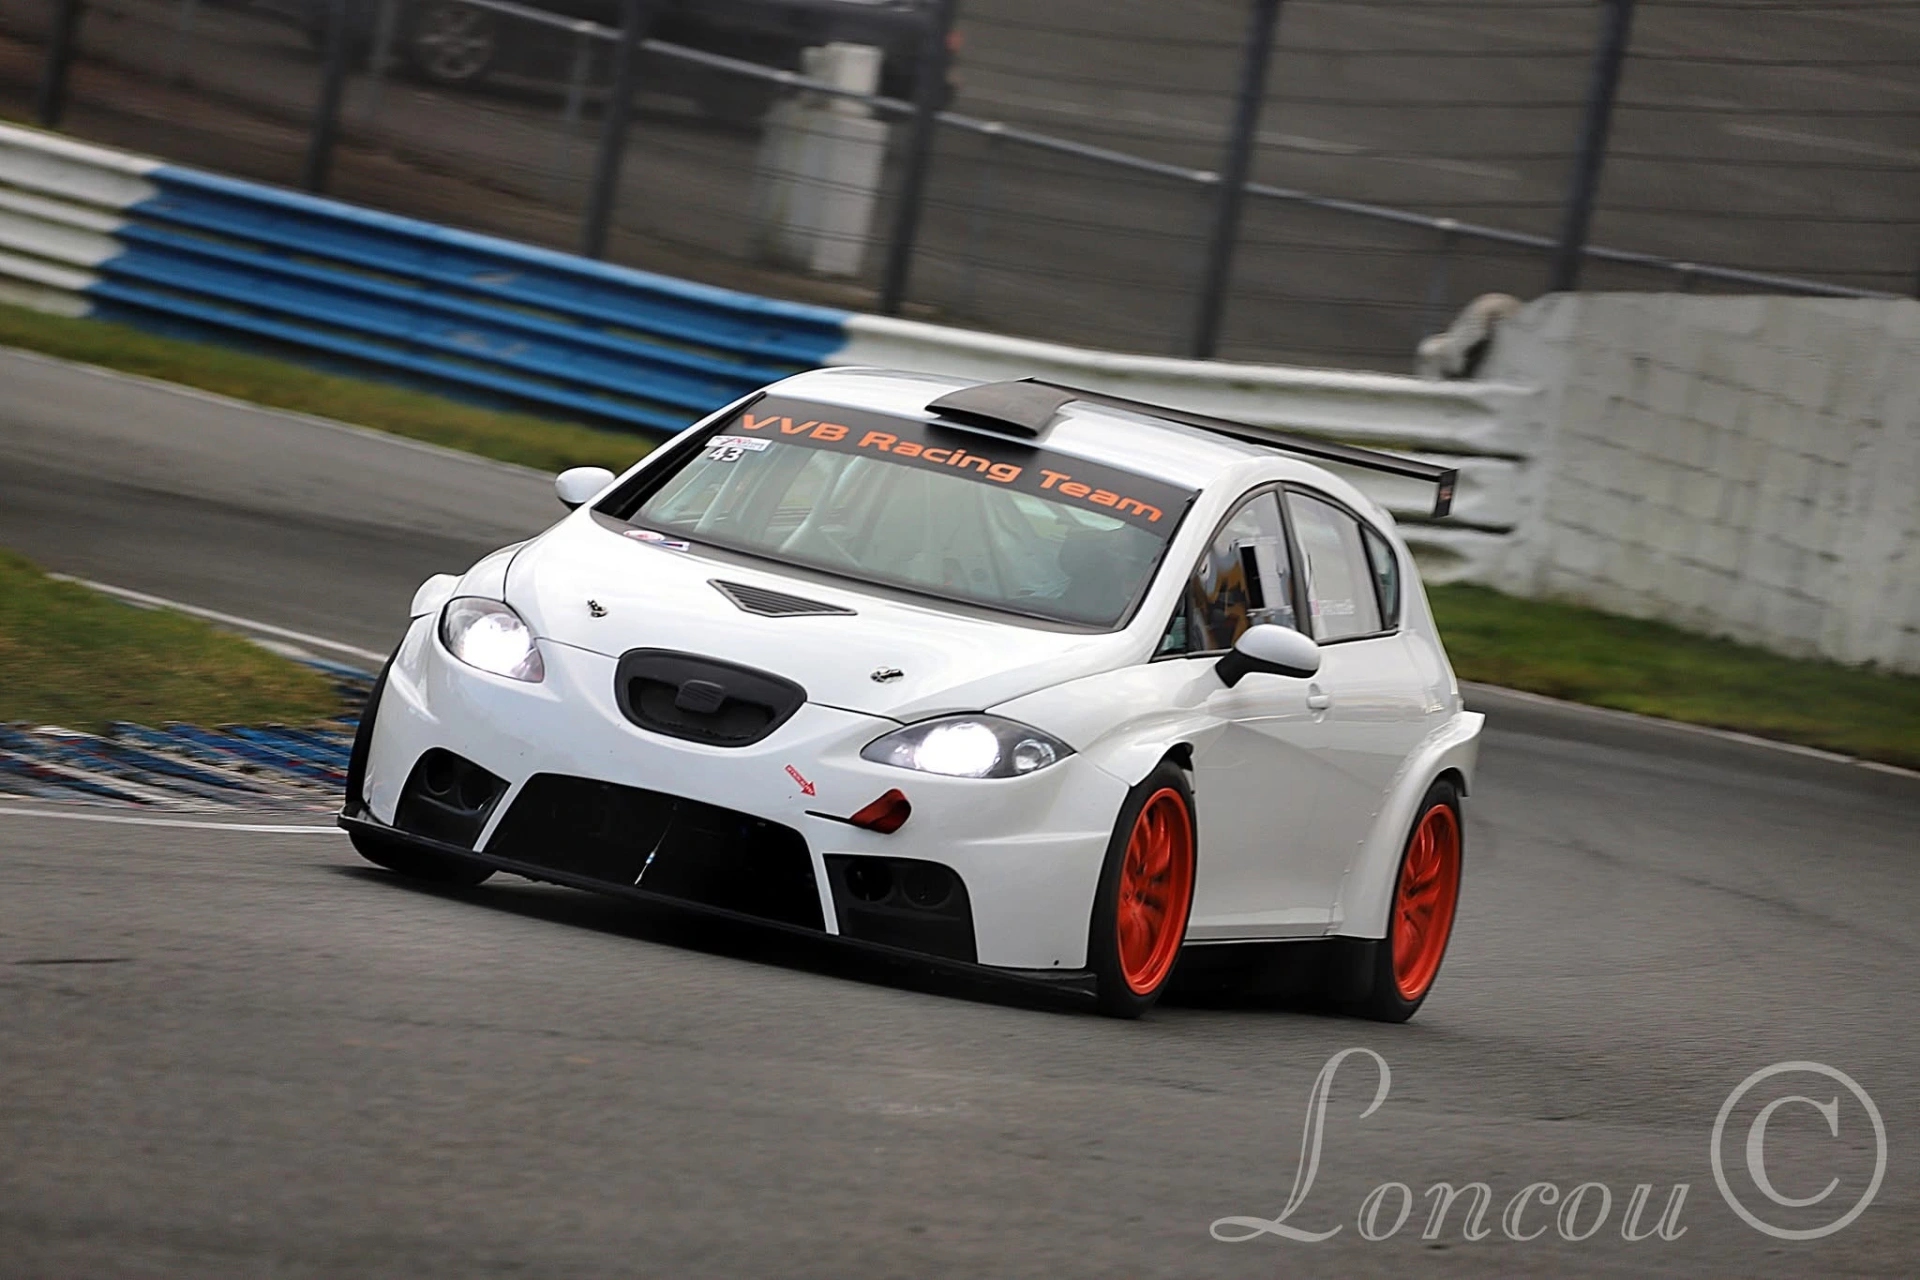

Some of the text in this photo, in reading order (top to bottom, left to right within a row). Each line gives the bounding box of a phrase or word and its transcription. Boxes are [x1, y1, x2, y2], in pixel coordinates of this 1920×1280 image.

[708, 446, 744, 462] 43
[741, 413, 1163, 522] VVB Racing Team
